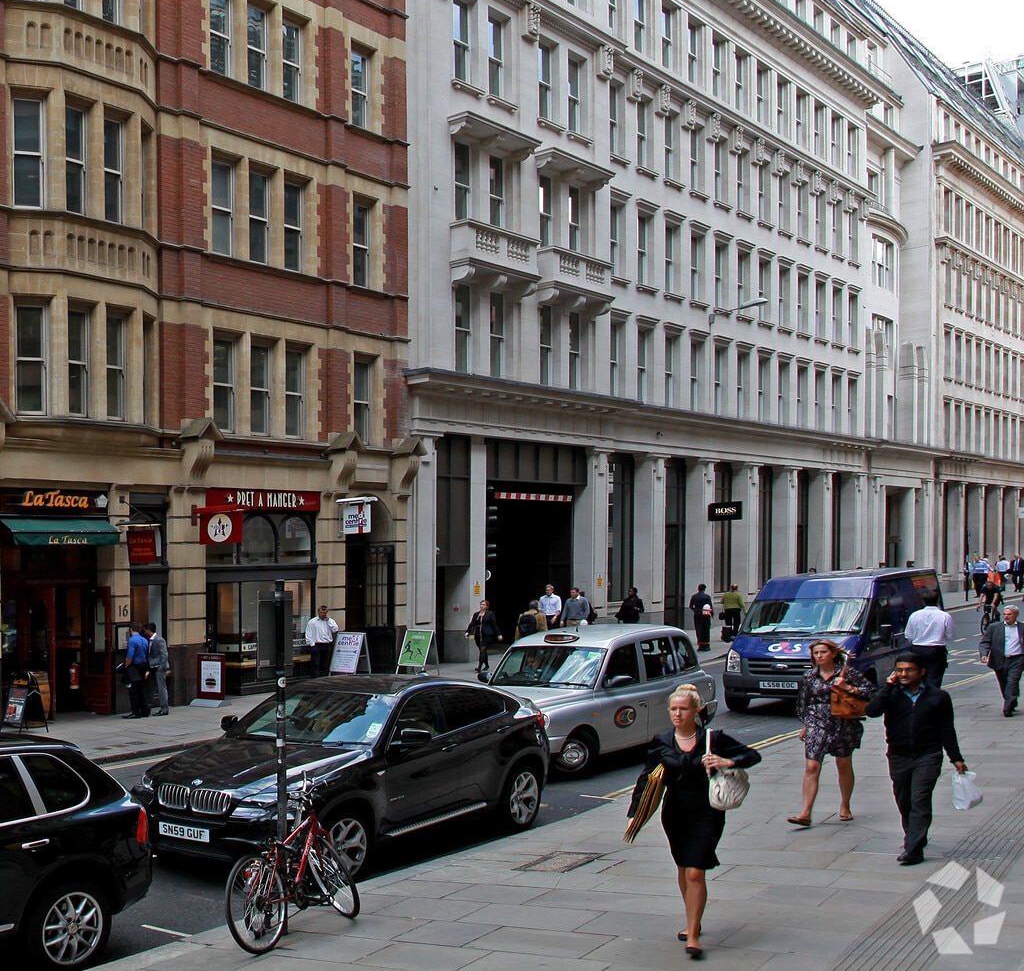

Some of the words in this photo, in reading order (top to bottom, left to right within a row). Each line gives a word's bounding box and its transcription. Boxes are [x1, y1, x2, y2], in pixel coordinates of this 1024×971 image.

[22, 490, 44, 507] La
[44, 489, 89, 509] Tasca
[236, 491, 254, 507] PRET
[258, 491, 264, 507] A
[267, 492, 297, 508] MANGER
[48, 535, 59, 544] La
[61, 535, 88, 545] Tasca
[118, 604, 129, 617] 16
[768, 642, 802, 654] G4S
[162, 824, 185, 837] SN59
[186, 829, 205, 840] GUF
